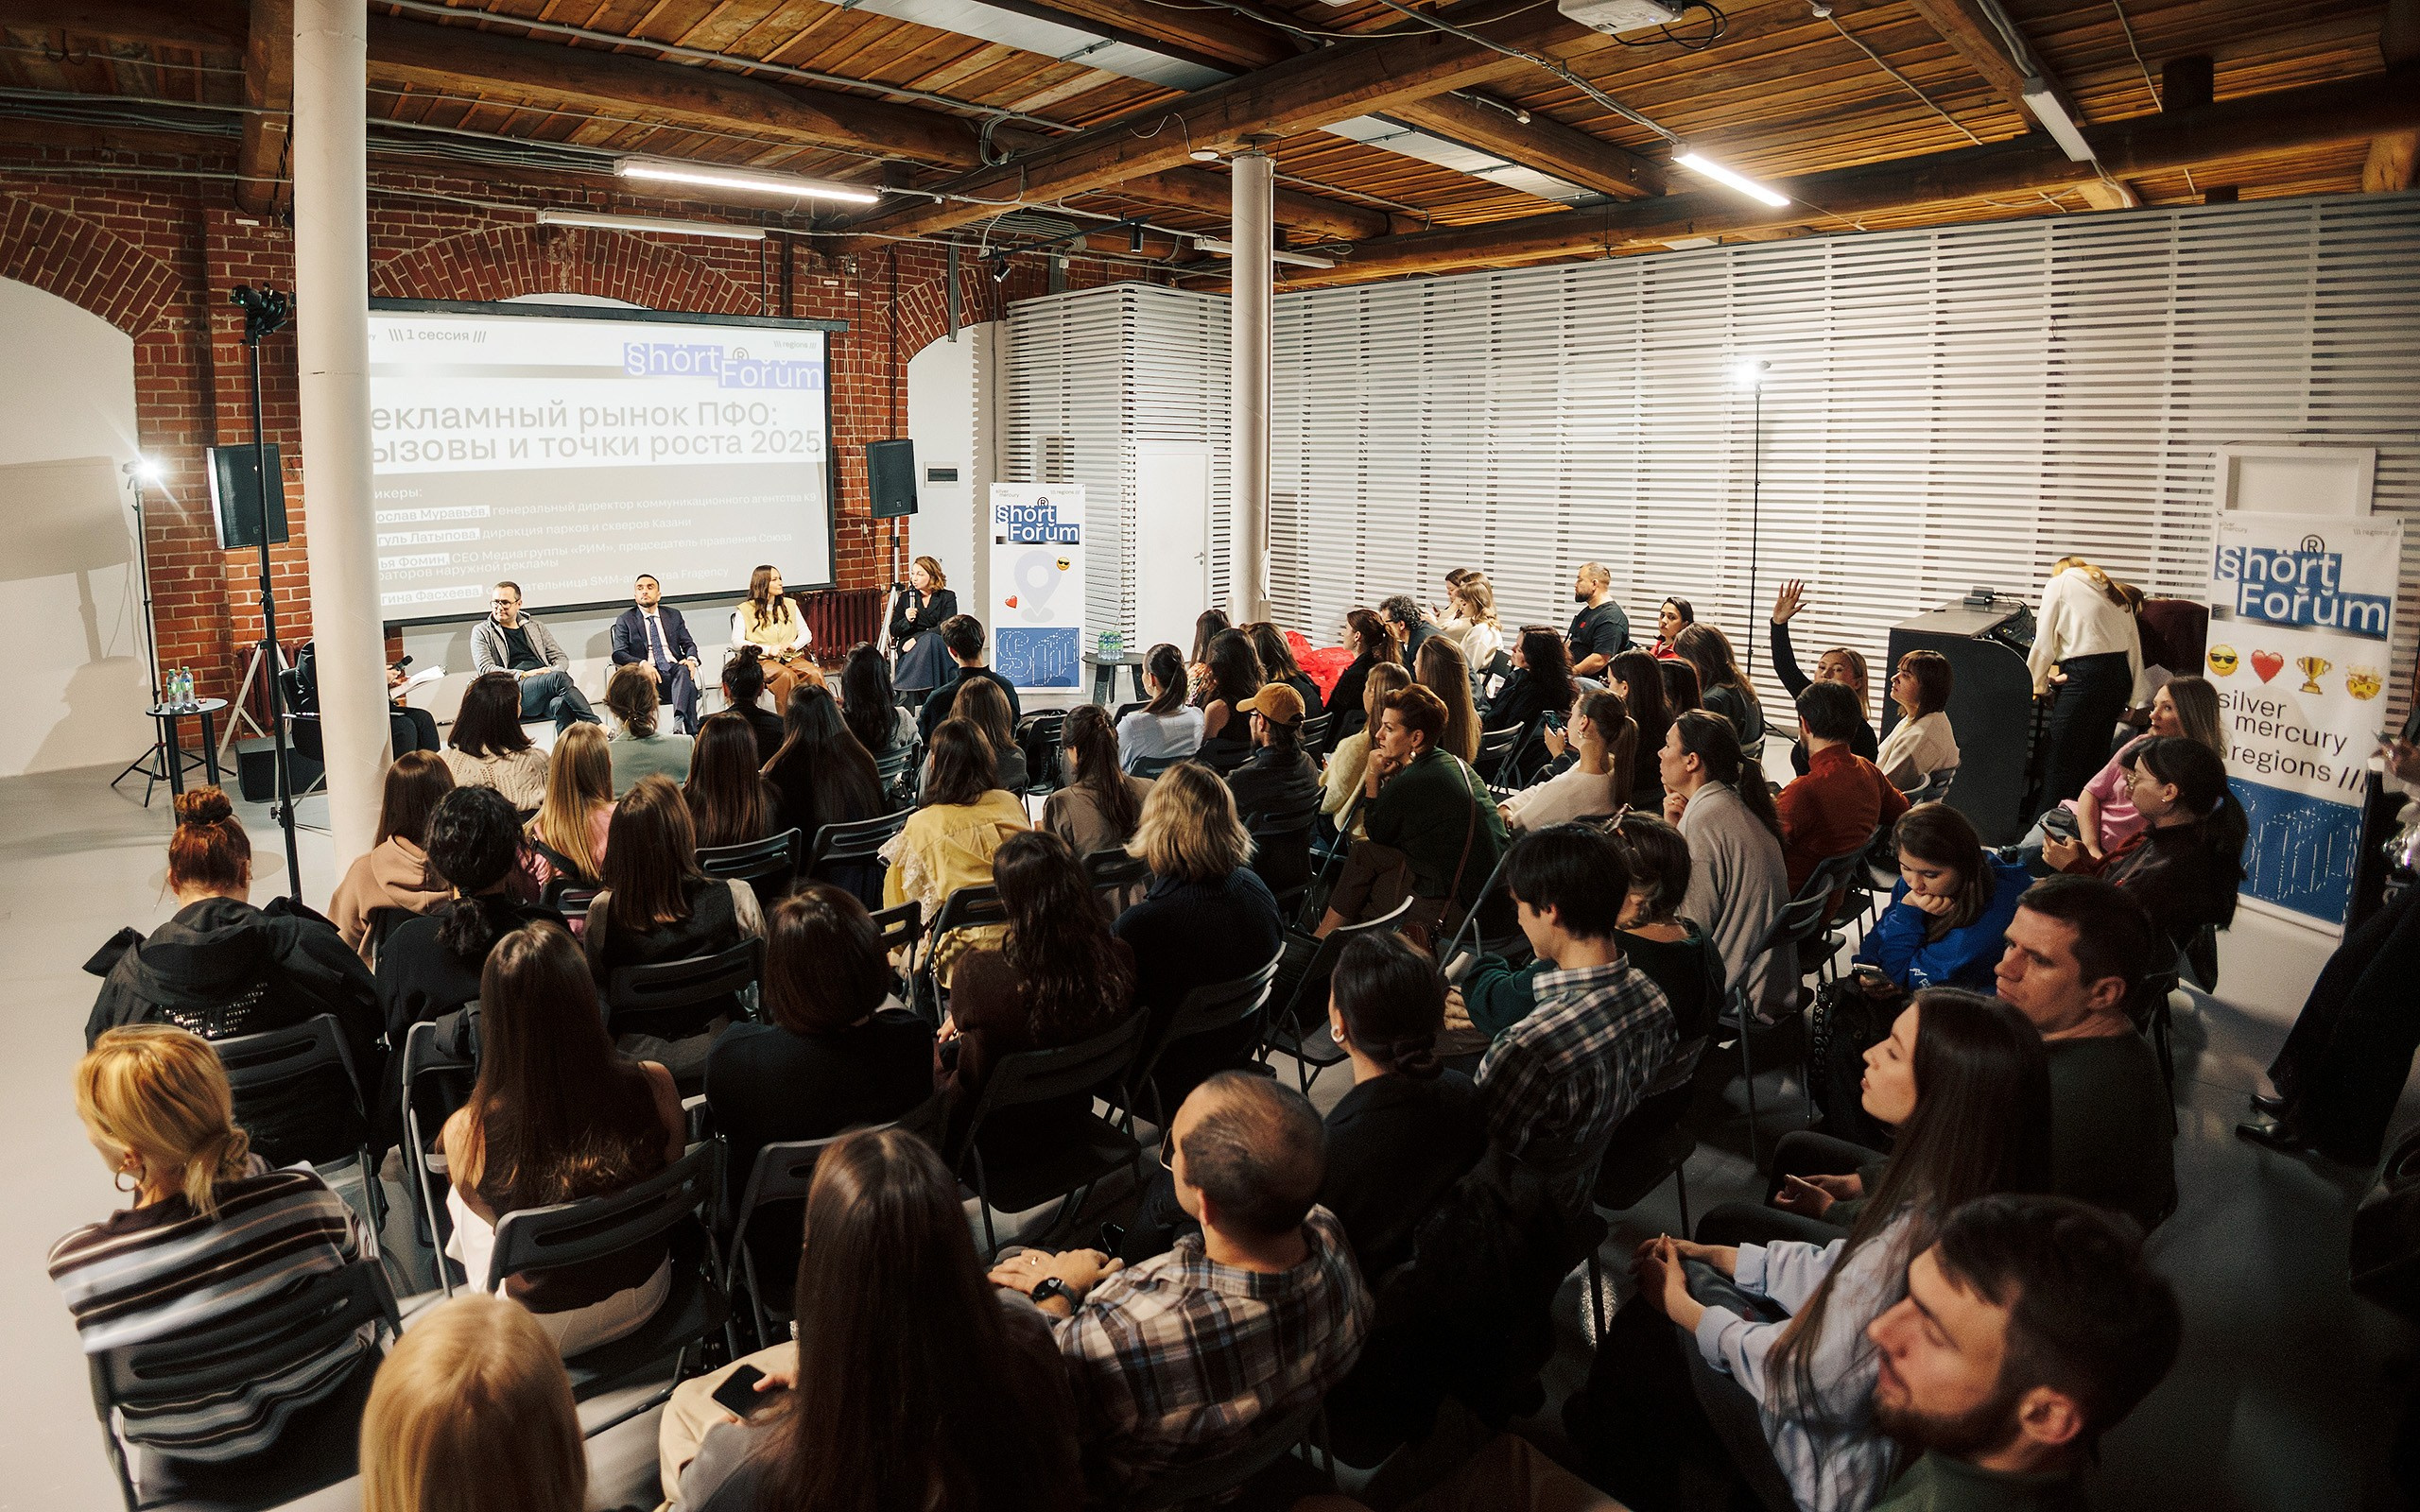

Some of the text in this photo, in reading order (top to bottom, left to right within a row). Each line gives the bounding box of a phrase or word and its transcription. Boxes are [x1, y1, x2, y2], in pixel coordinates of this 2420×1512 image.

[406, 329, 415, 340] 1
[418, 331, 470, 341] сессия
[783, 341, 808, 351] regions
[371, 399, 778, 434] екламный рынок ПФО:
[372, 429, 821, 463] ызовы и точки роста 2025
[374, 488, 423, 501] икеры:
[377, 511, 417, 523] ослав
[493, 501, 576, 517] генеральный
[578, 500, 634, 514] директор
[637, 495, 751, 510] коммуникационного
[752, 493, 803, 504] агентства
[378, 518, 692, 546] гуль Латыпова, дирекция парков и скверов Казани
[482, 546, 568, 561] Медиагруппы
[618, 539, 698, 553] председатель
[700, 536, 757, 548] правления
[758, 532, 792, 543] Союза
[379, 558, 560, 582] раторов наружной рекламы
[381, 593, 413, 606] гина
[485, 579, 588, 595] оательница
[589, 572, 679, 587] SMM-агства
[681, 567, 730, 580] Fragency
[2219, 690, 2287, 719] silver
[2235, 714, 2347, 757] mercury
[2231, 745, 2331, 782] regions
